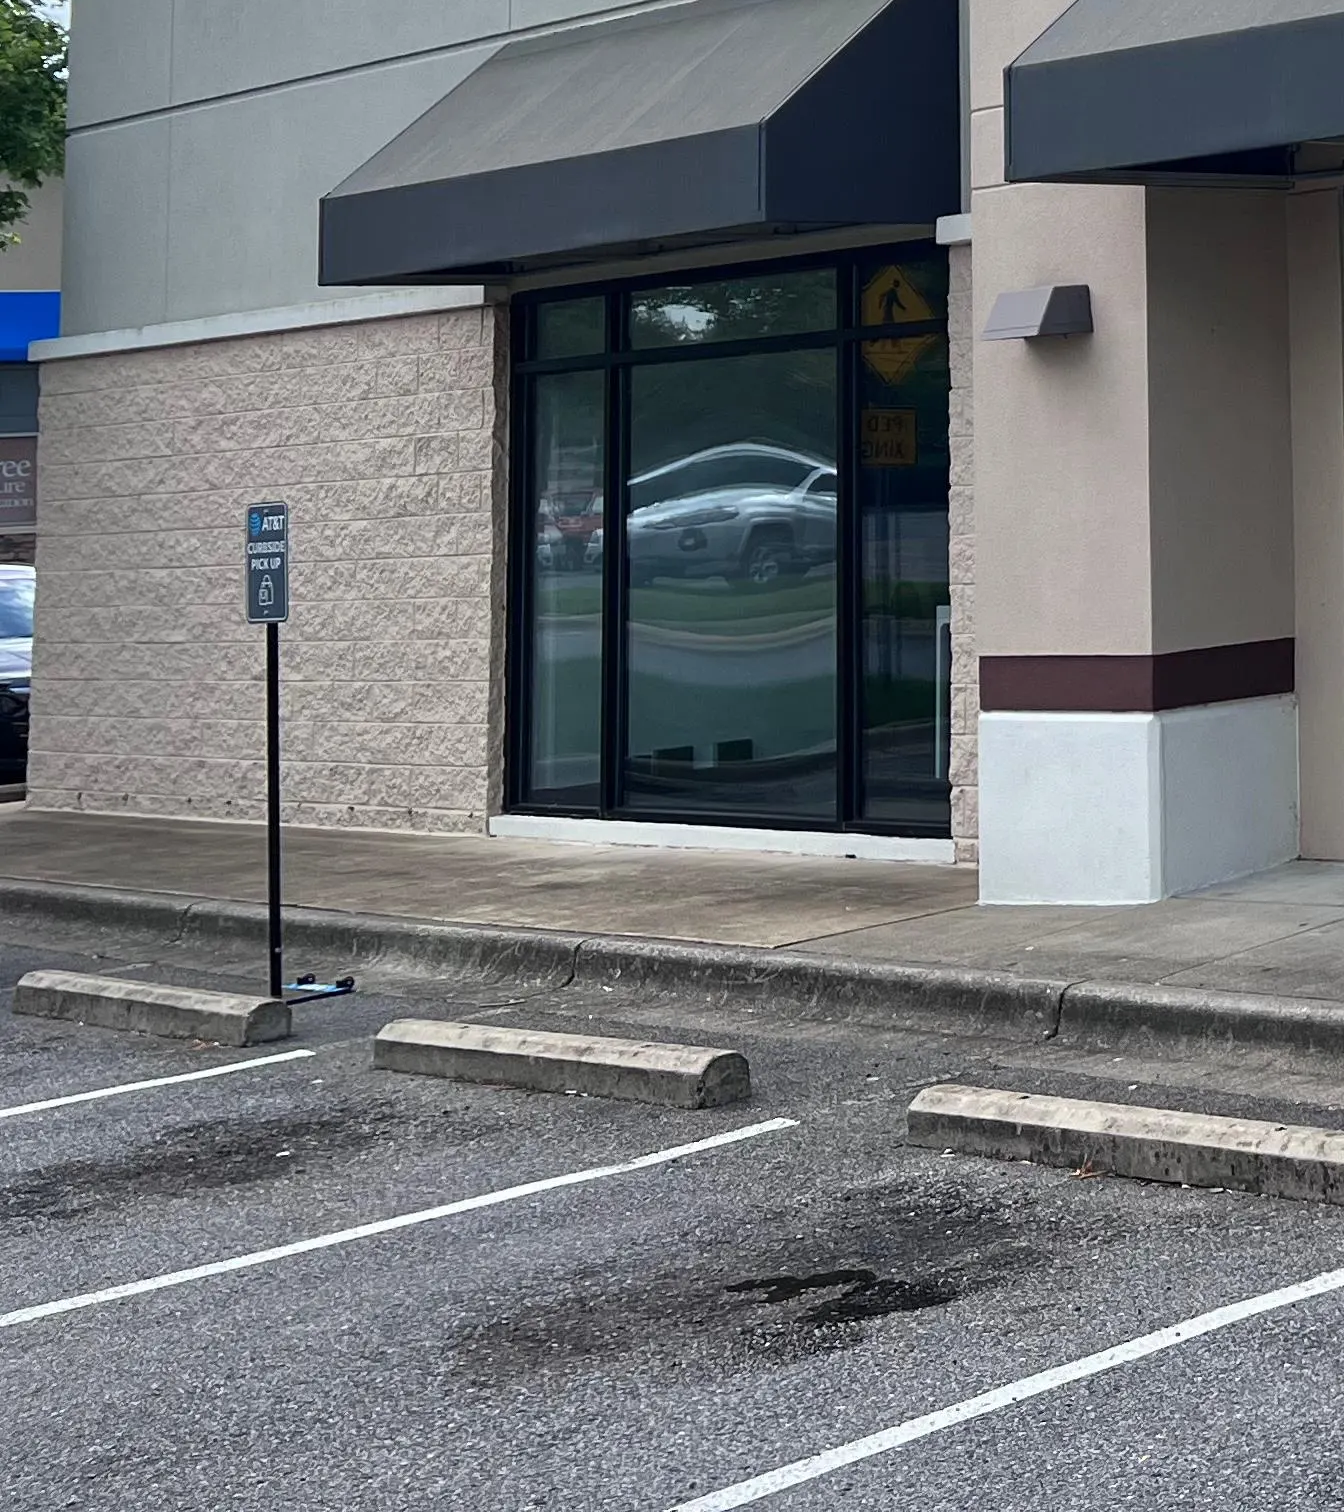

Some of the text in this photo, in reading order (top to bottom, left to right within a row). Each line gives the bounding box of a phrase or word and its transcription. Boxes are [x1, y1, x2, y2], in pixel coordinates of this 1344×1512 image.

[261, 515, 285, 531] AT&T
[247, 540, 286, 554] CURBSIDE
[251, 557, 281, 571] PICK UP
